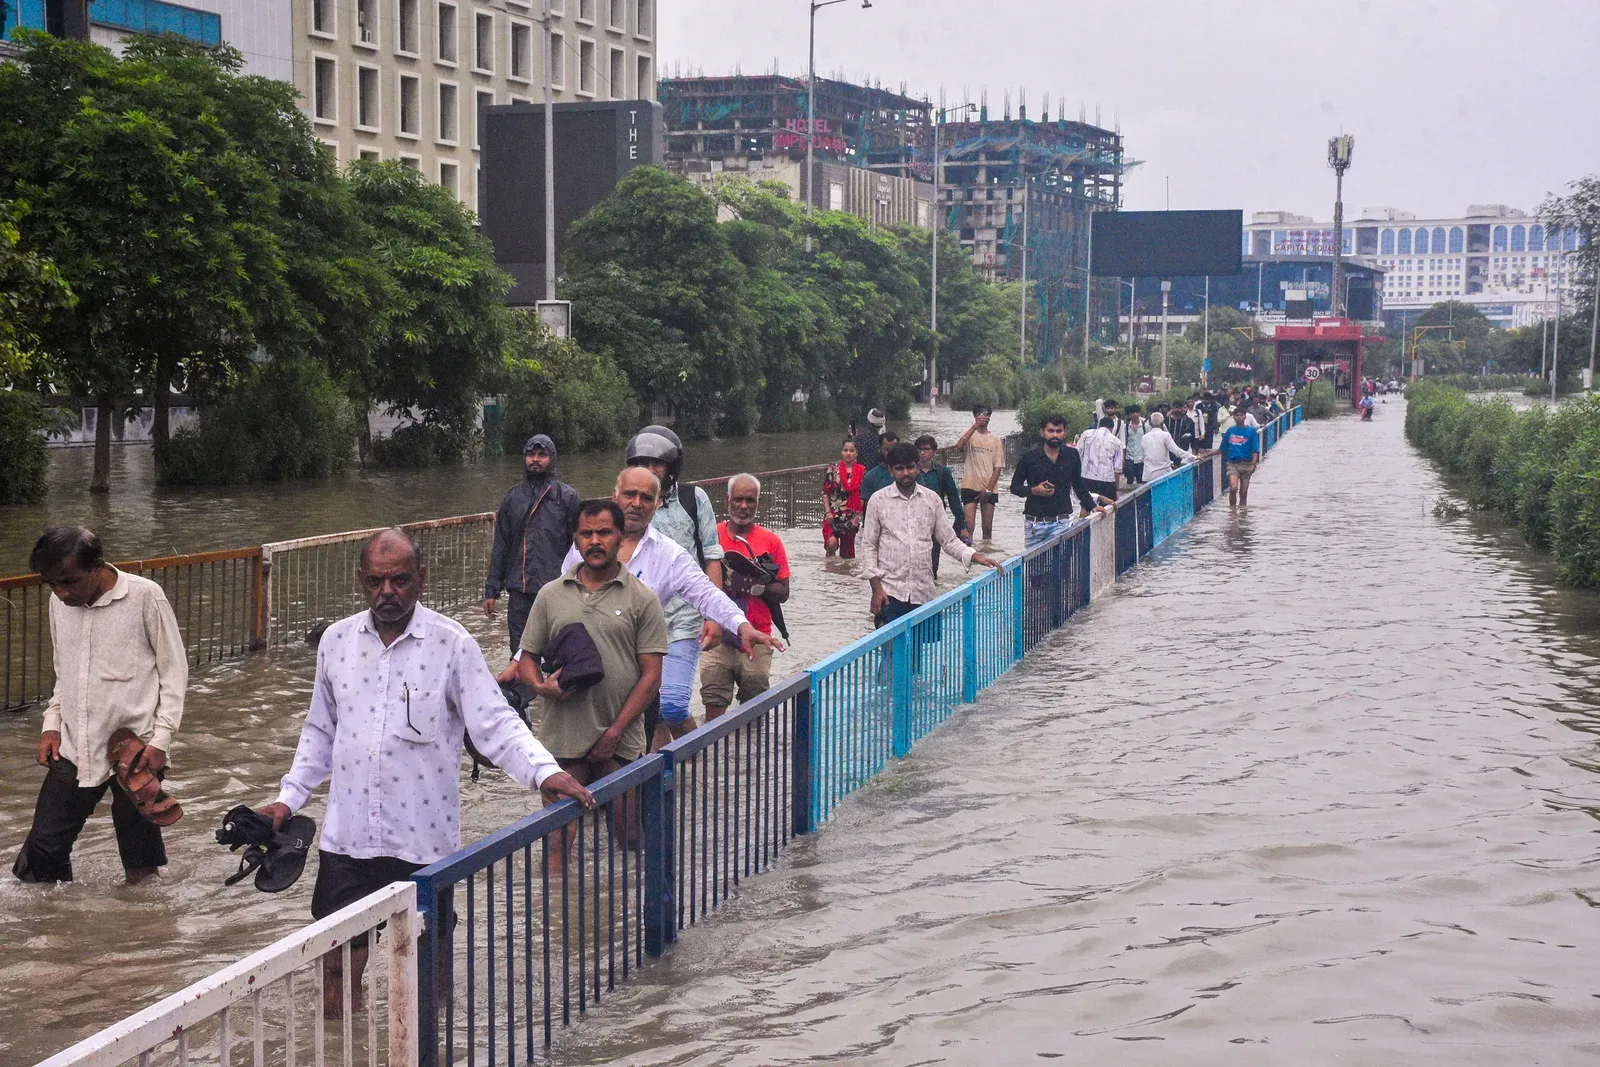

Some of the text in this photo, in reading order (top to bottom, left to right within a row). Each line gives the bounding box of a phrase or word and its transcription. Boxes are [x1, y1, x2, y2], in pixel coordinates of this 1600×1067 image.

[629, 111, 637, 160] THE
[1274, 243, 1310, 252] CAPITAL
[1307, 369, 1317, 377] 30
